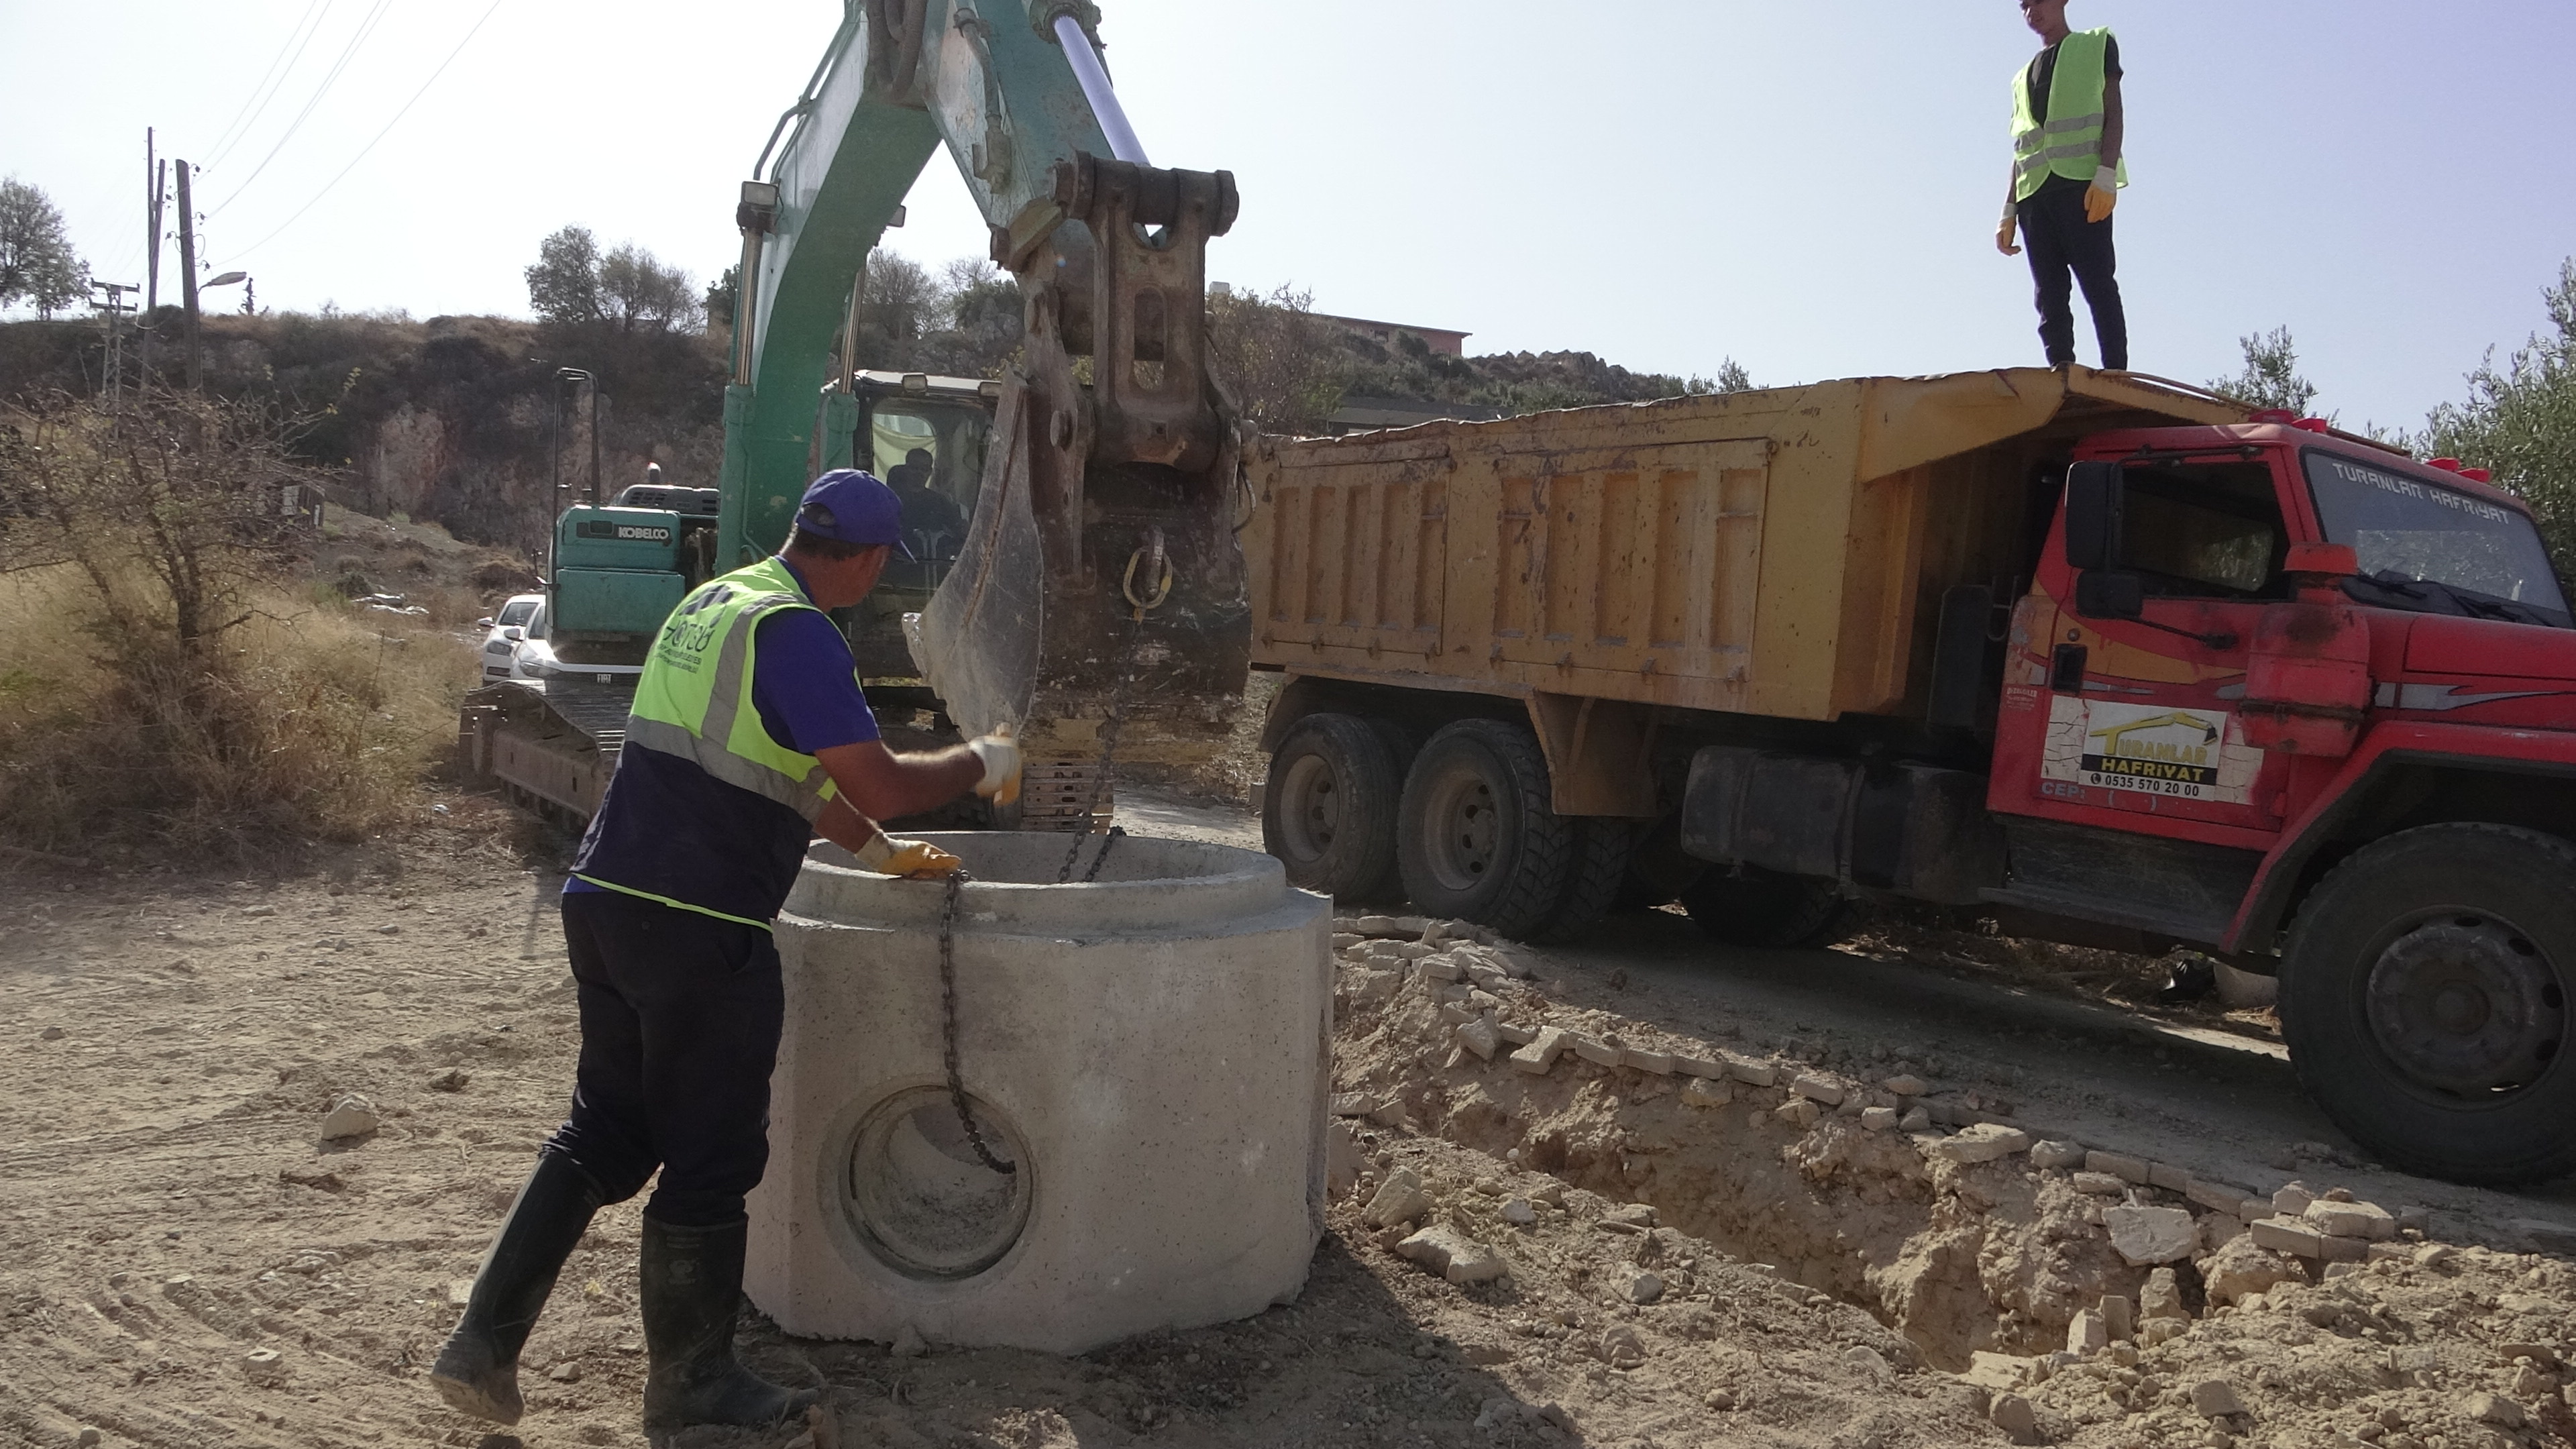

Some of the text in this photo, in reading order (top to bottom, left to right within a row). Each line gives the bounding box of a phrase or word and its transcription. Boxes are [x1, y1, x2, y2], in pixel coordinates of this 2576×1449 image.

[2332, 462, 2424, 500] TURANLAR
[618, 526, 669, 540] KOBELCO
[597, 674, 612, 684] FIAT
[2090, 723, 2208, 765] TURANLAR
[2104, 775, 2200, 797] 0535 570 20 00
